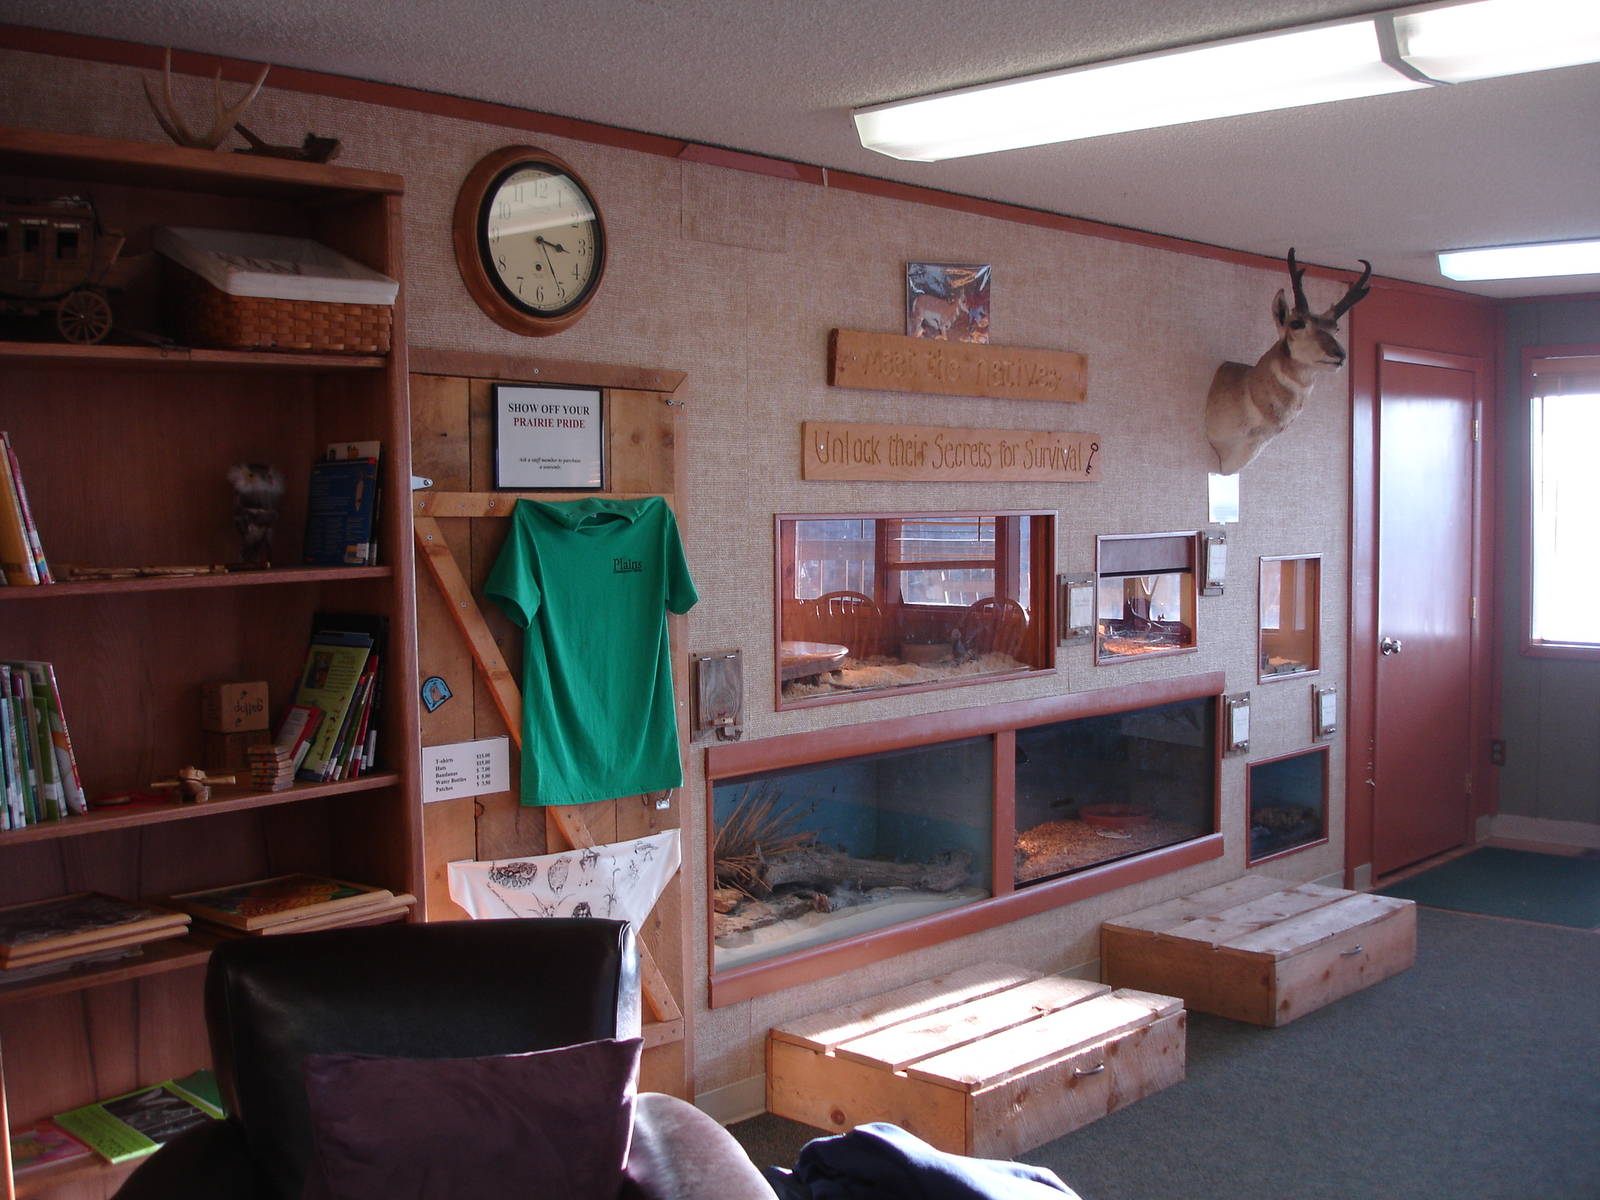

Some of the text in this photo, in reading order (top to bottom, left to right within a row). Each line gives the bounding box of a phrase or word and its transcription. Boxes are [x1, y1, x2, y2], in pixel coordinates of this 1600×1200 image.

[514, 185, 524, 203] 11
[534, 181, 548, 199] 12
[557, 190, 563, 208] 1
[499, 197, 511, 219] 10
[571, 211, 579, 228] 2
[491, 225, 500, 243] 9
[578, 239, 586, 256] 3
[498, 256, 507, 272] 8
[571, 263, 580, 280] 4
[516, 276, 524, 294] 7
[536, 286, 544, 302] 6
[557, 281, 566, 299] 5
[928, 350, 961, 384] the
[508, 403, 590, 415] SHOW OFF YOUR
[513, 417, 586, 429] PRAIRIE PRIDE
[814, 430, 1083, 472] Unlock their Secrets for Survival
[613, 558, 641, 569] Plains
